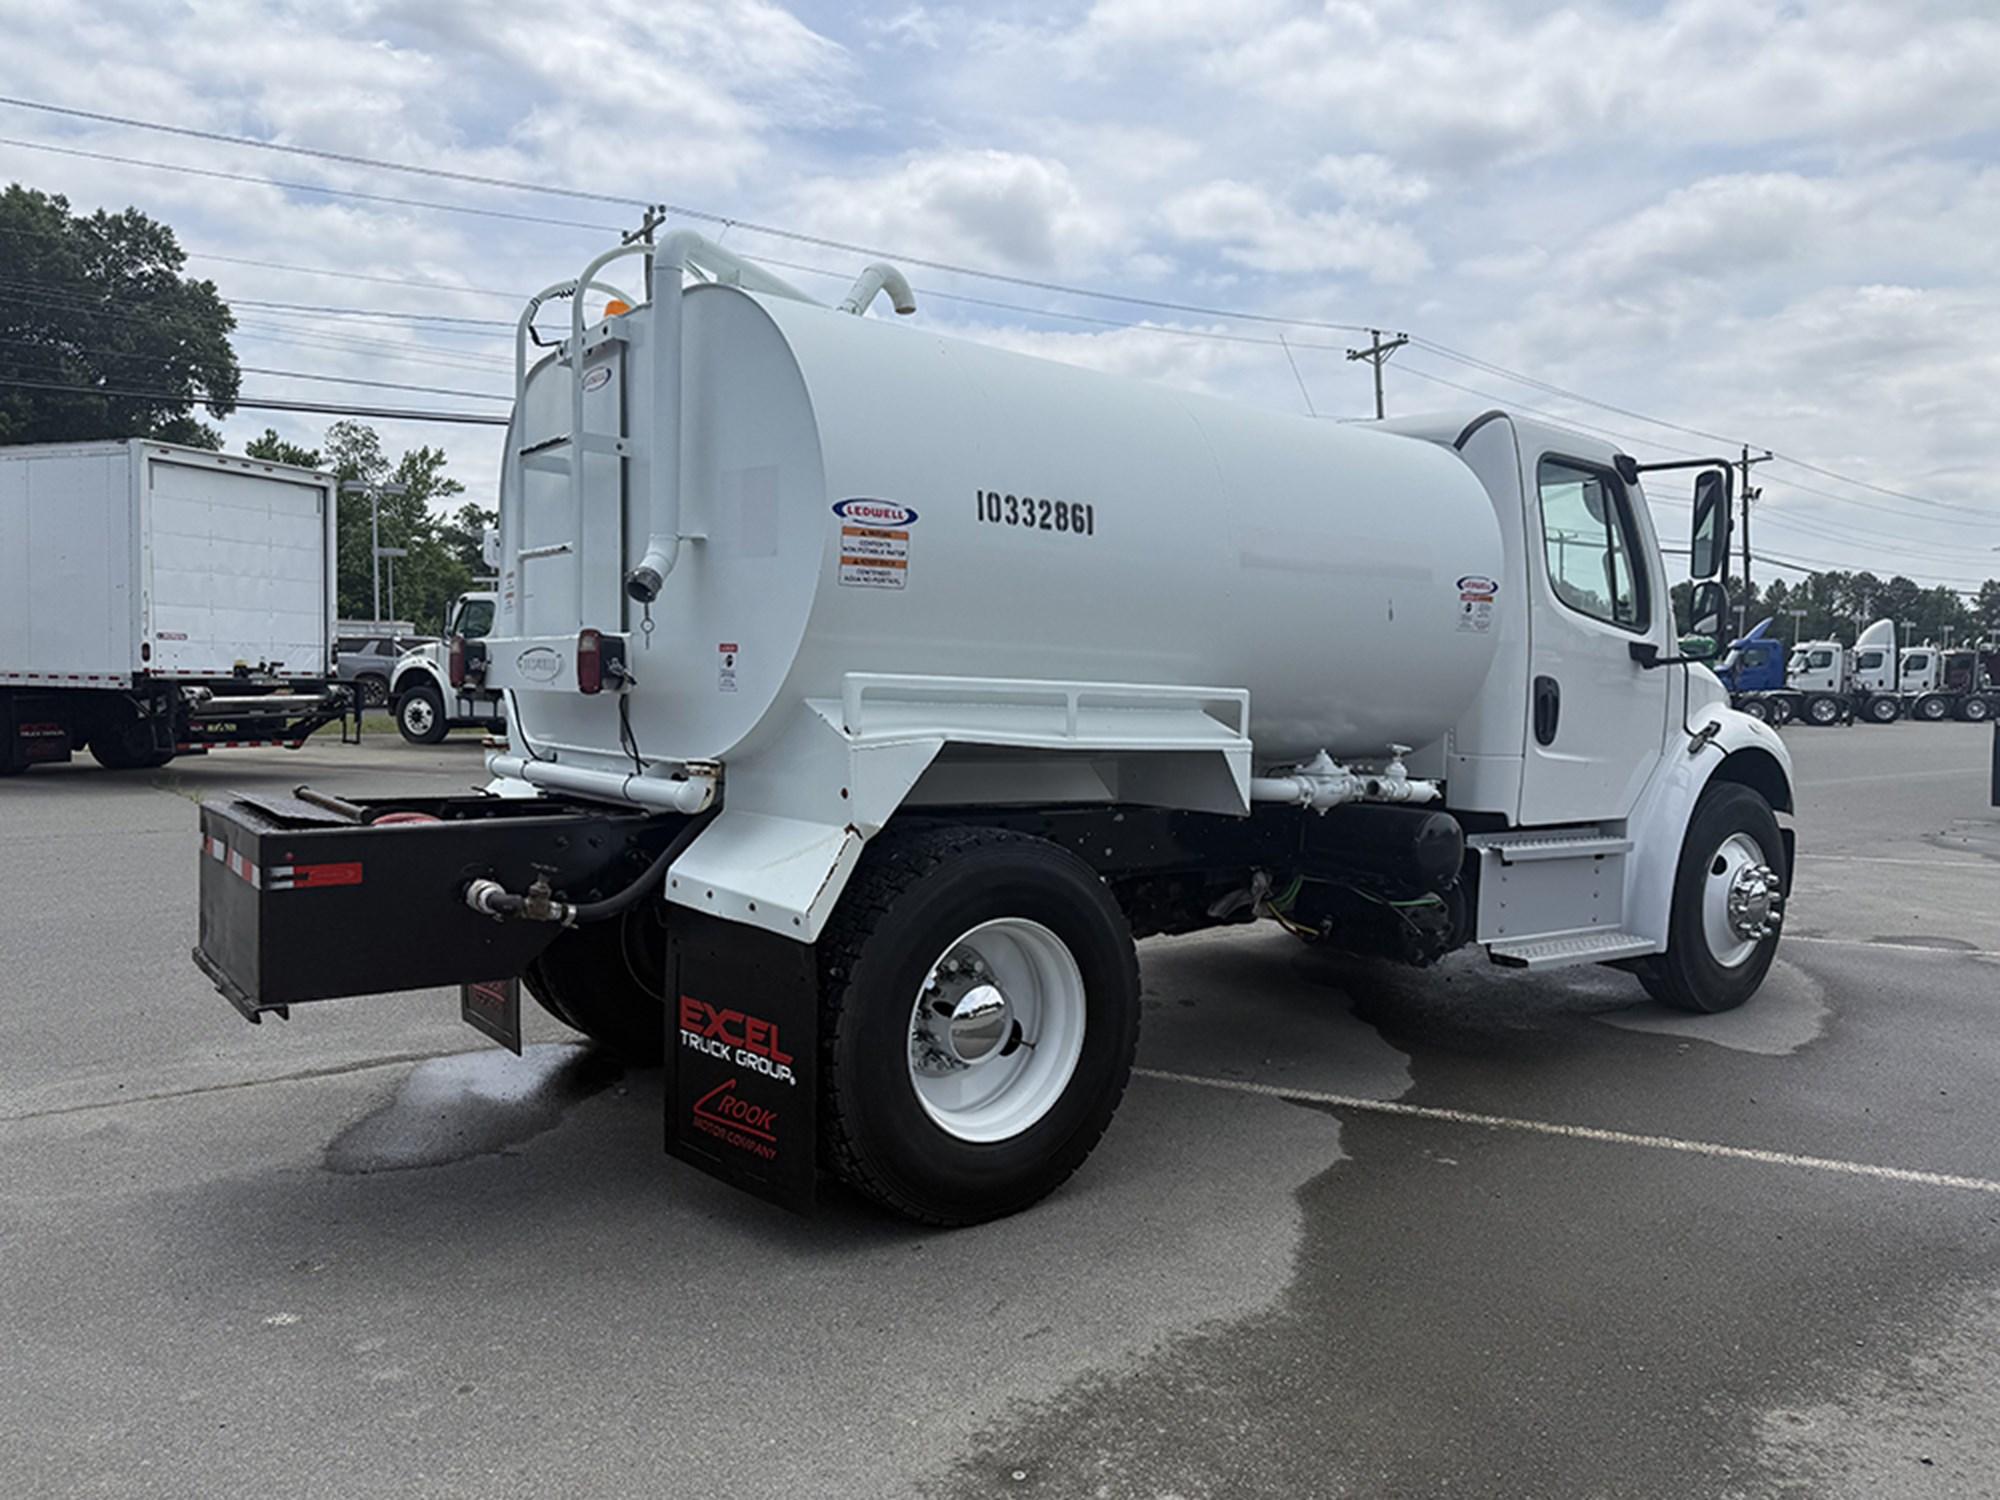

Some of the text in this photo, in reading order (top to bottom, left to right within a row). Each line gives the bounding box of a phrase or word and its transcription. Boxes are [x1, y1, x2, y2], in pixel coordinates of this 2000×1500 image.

[846, 505, 905, 520] LEDWELL
[977, 490, 1094, 536] 10332861
[679, 994, 794, 1066] EXCEL
[680, 1029, 732, 1062] TRUCK
[727, 1130, 778, 1160] COMPANY
